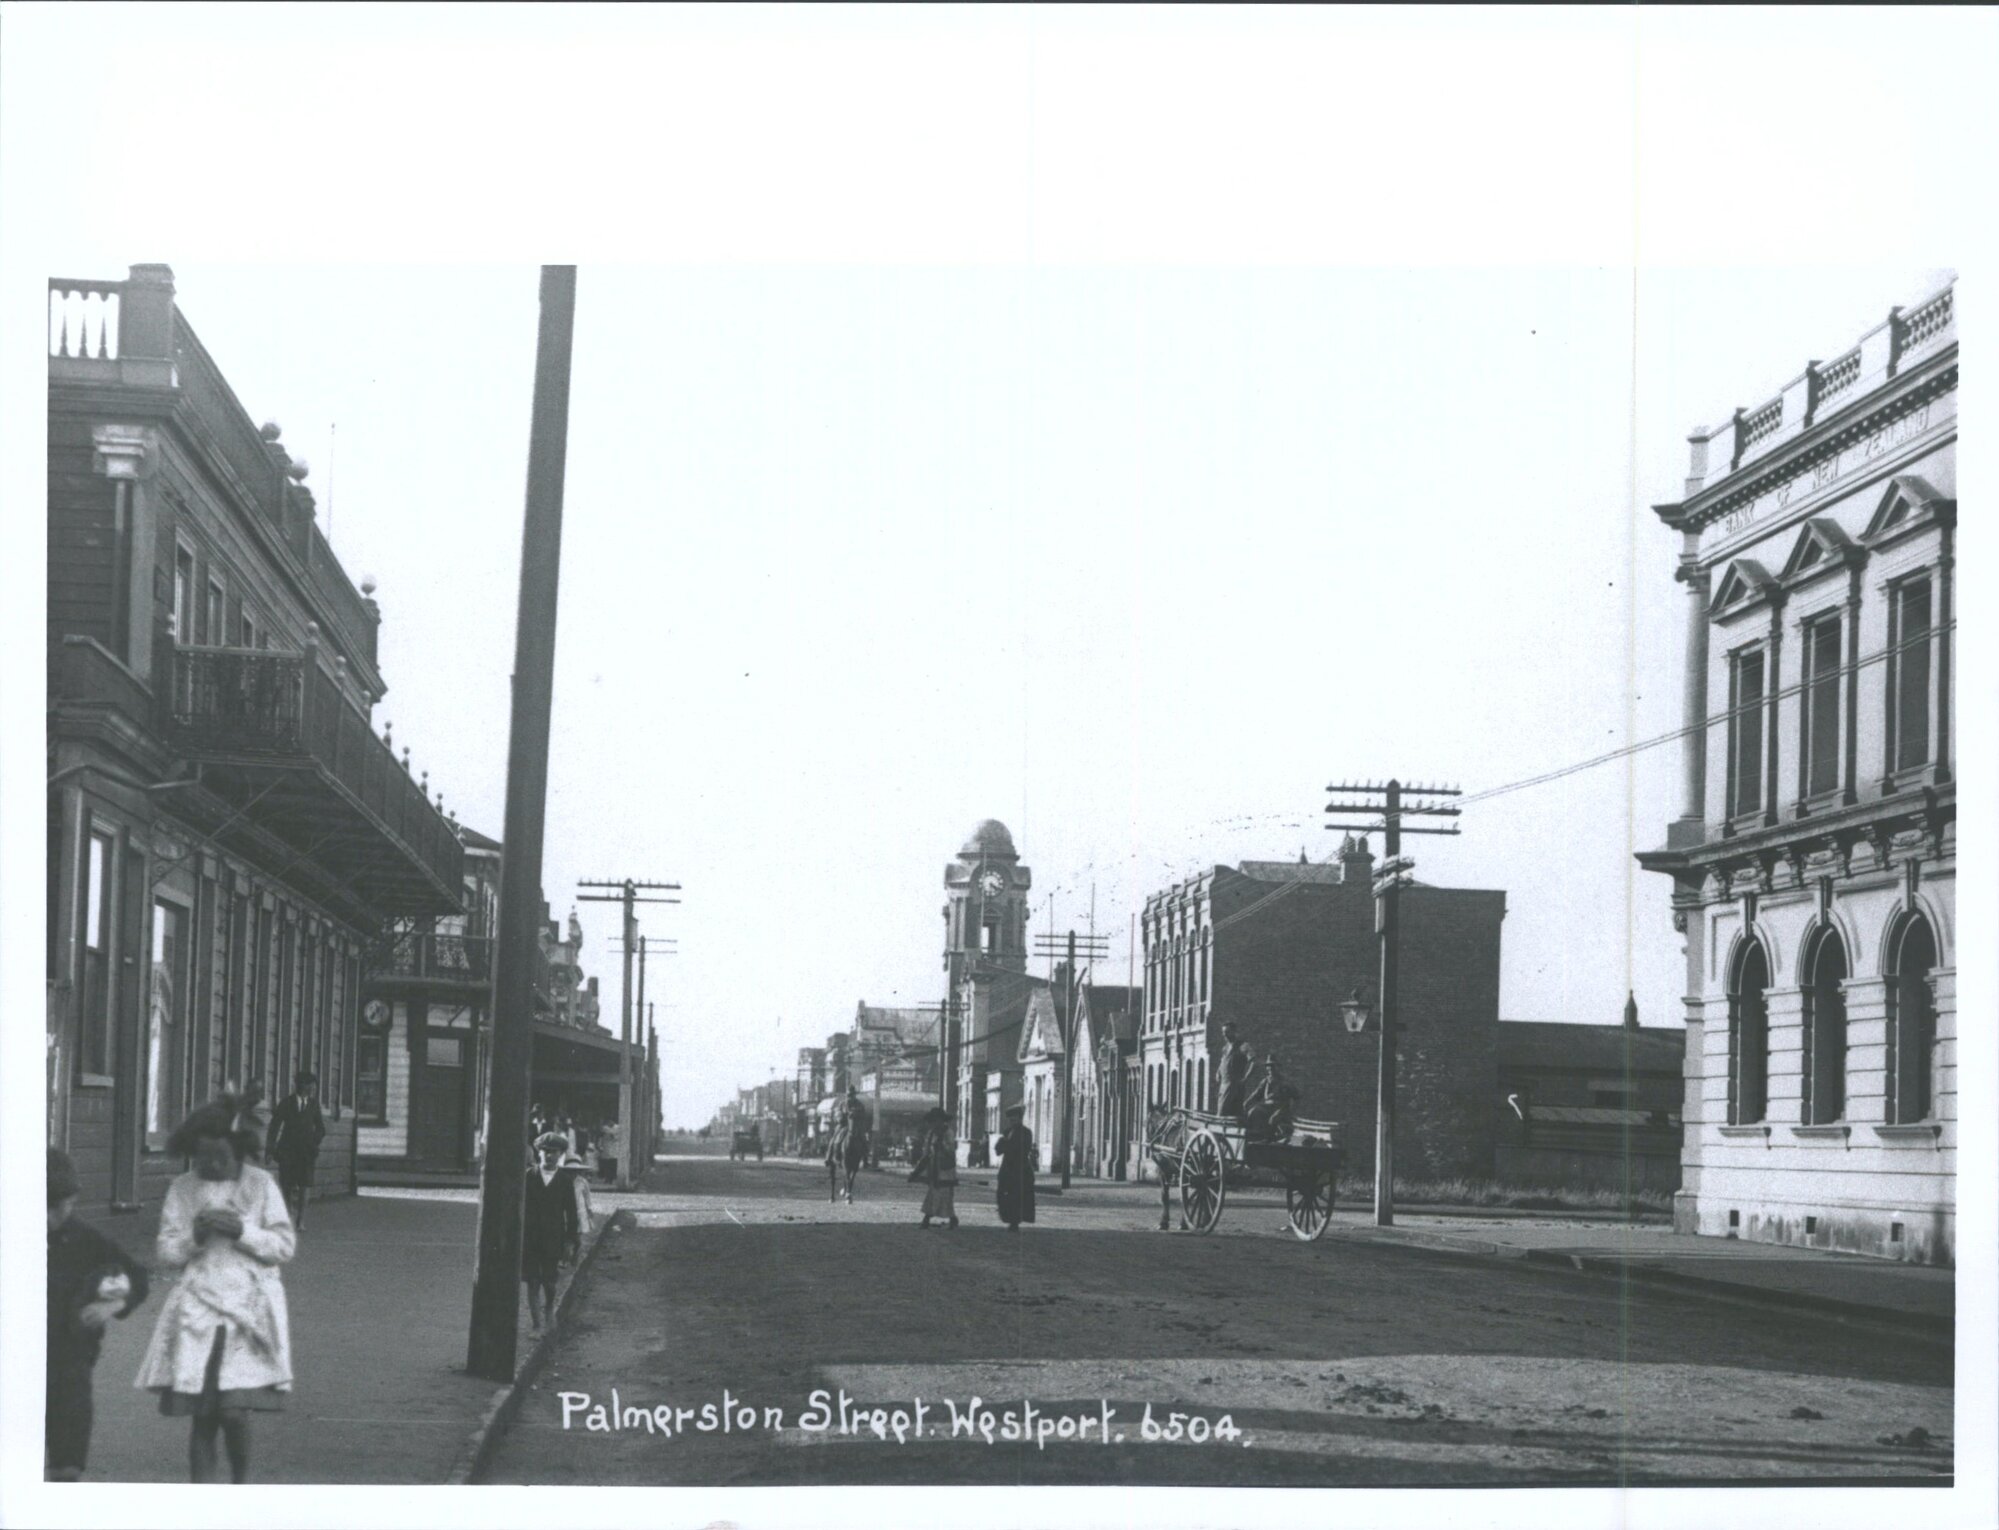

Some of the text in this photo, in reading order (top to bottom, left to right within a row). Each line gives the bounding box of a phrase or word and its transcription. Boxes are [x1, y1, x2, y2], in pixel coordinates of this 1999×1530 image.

[1725, 502, 1756, 535] BANK
[1777, 482, 1793, 508] OF
[1813, 455, 1840, 490] NEW
